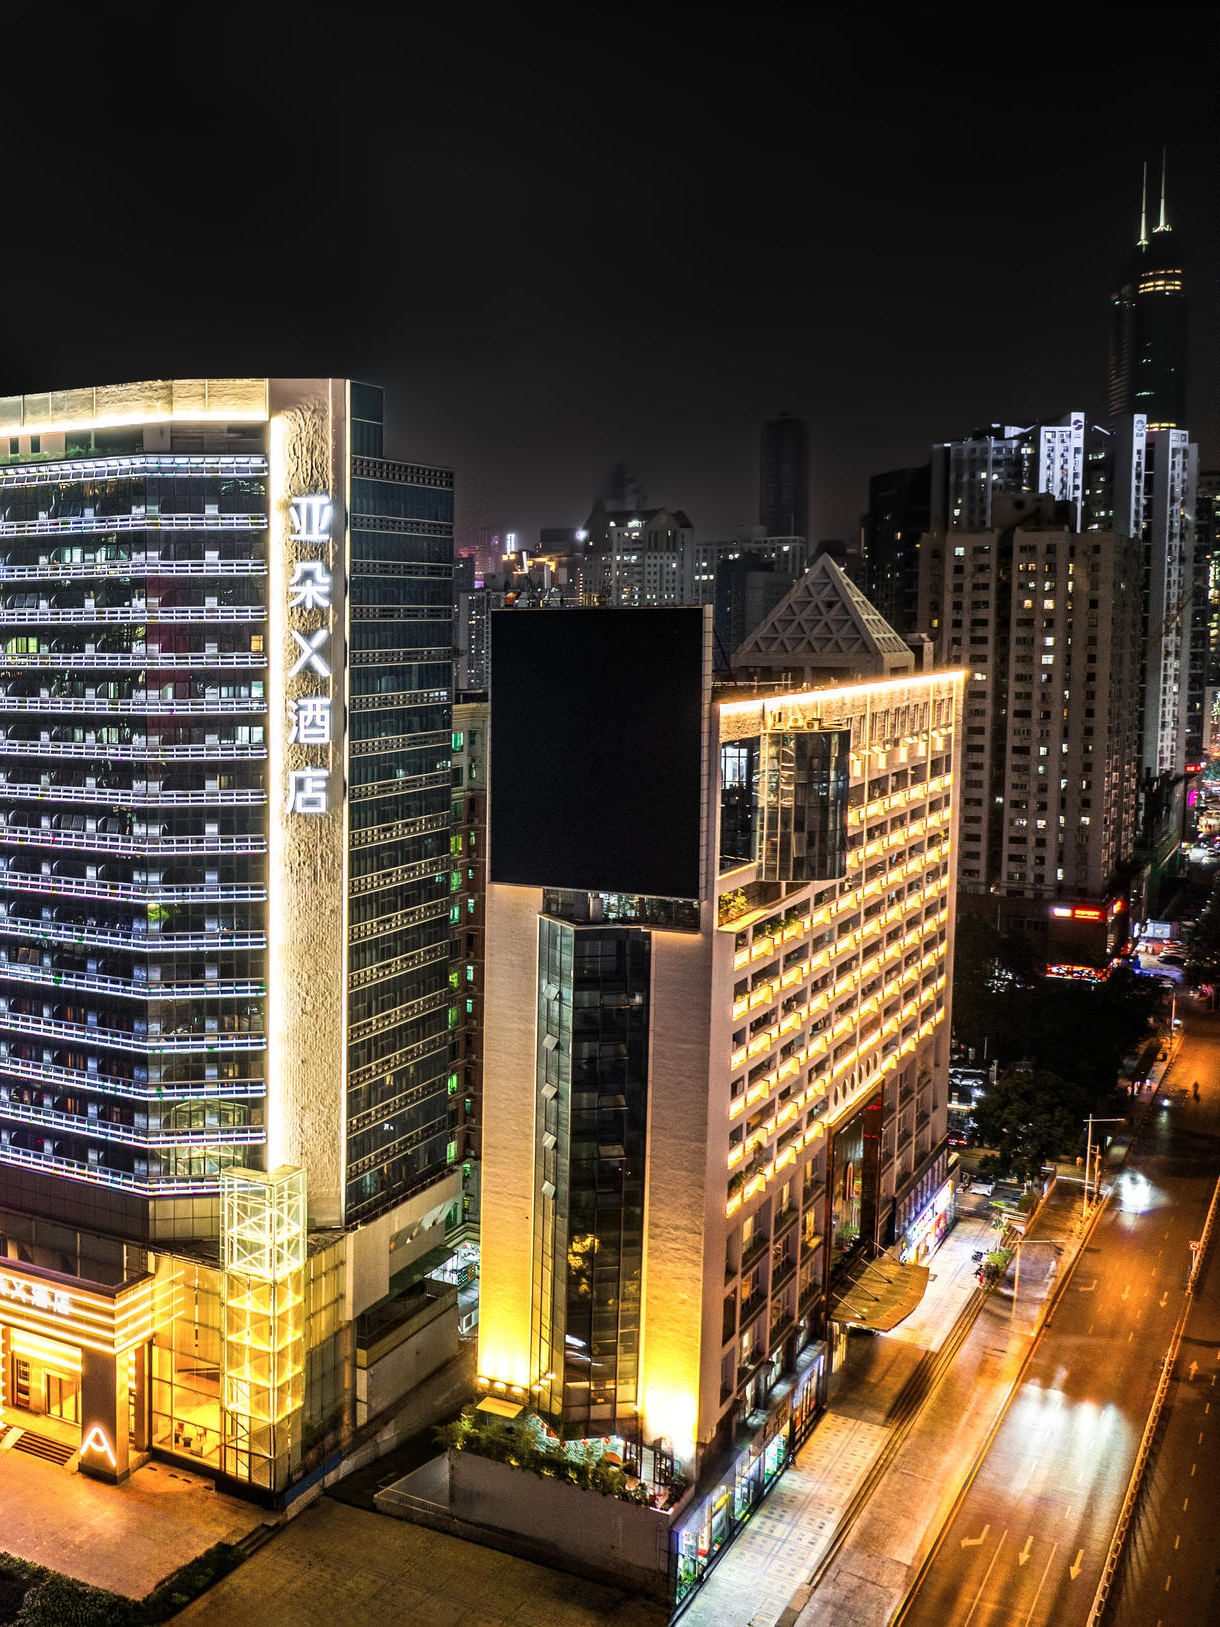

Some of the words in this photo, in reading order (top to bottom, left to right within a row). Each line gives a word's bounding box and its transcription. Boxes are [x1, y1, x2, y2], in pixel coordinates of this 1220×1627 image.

[288, 496, 331, 815] 亚朵X酒店
[81, 1427, 116, 1466] A
